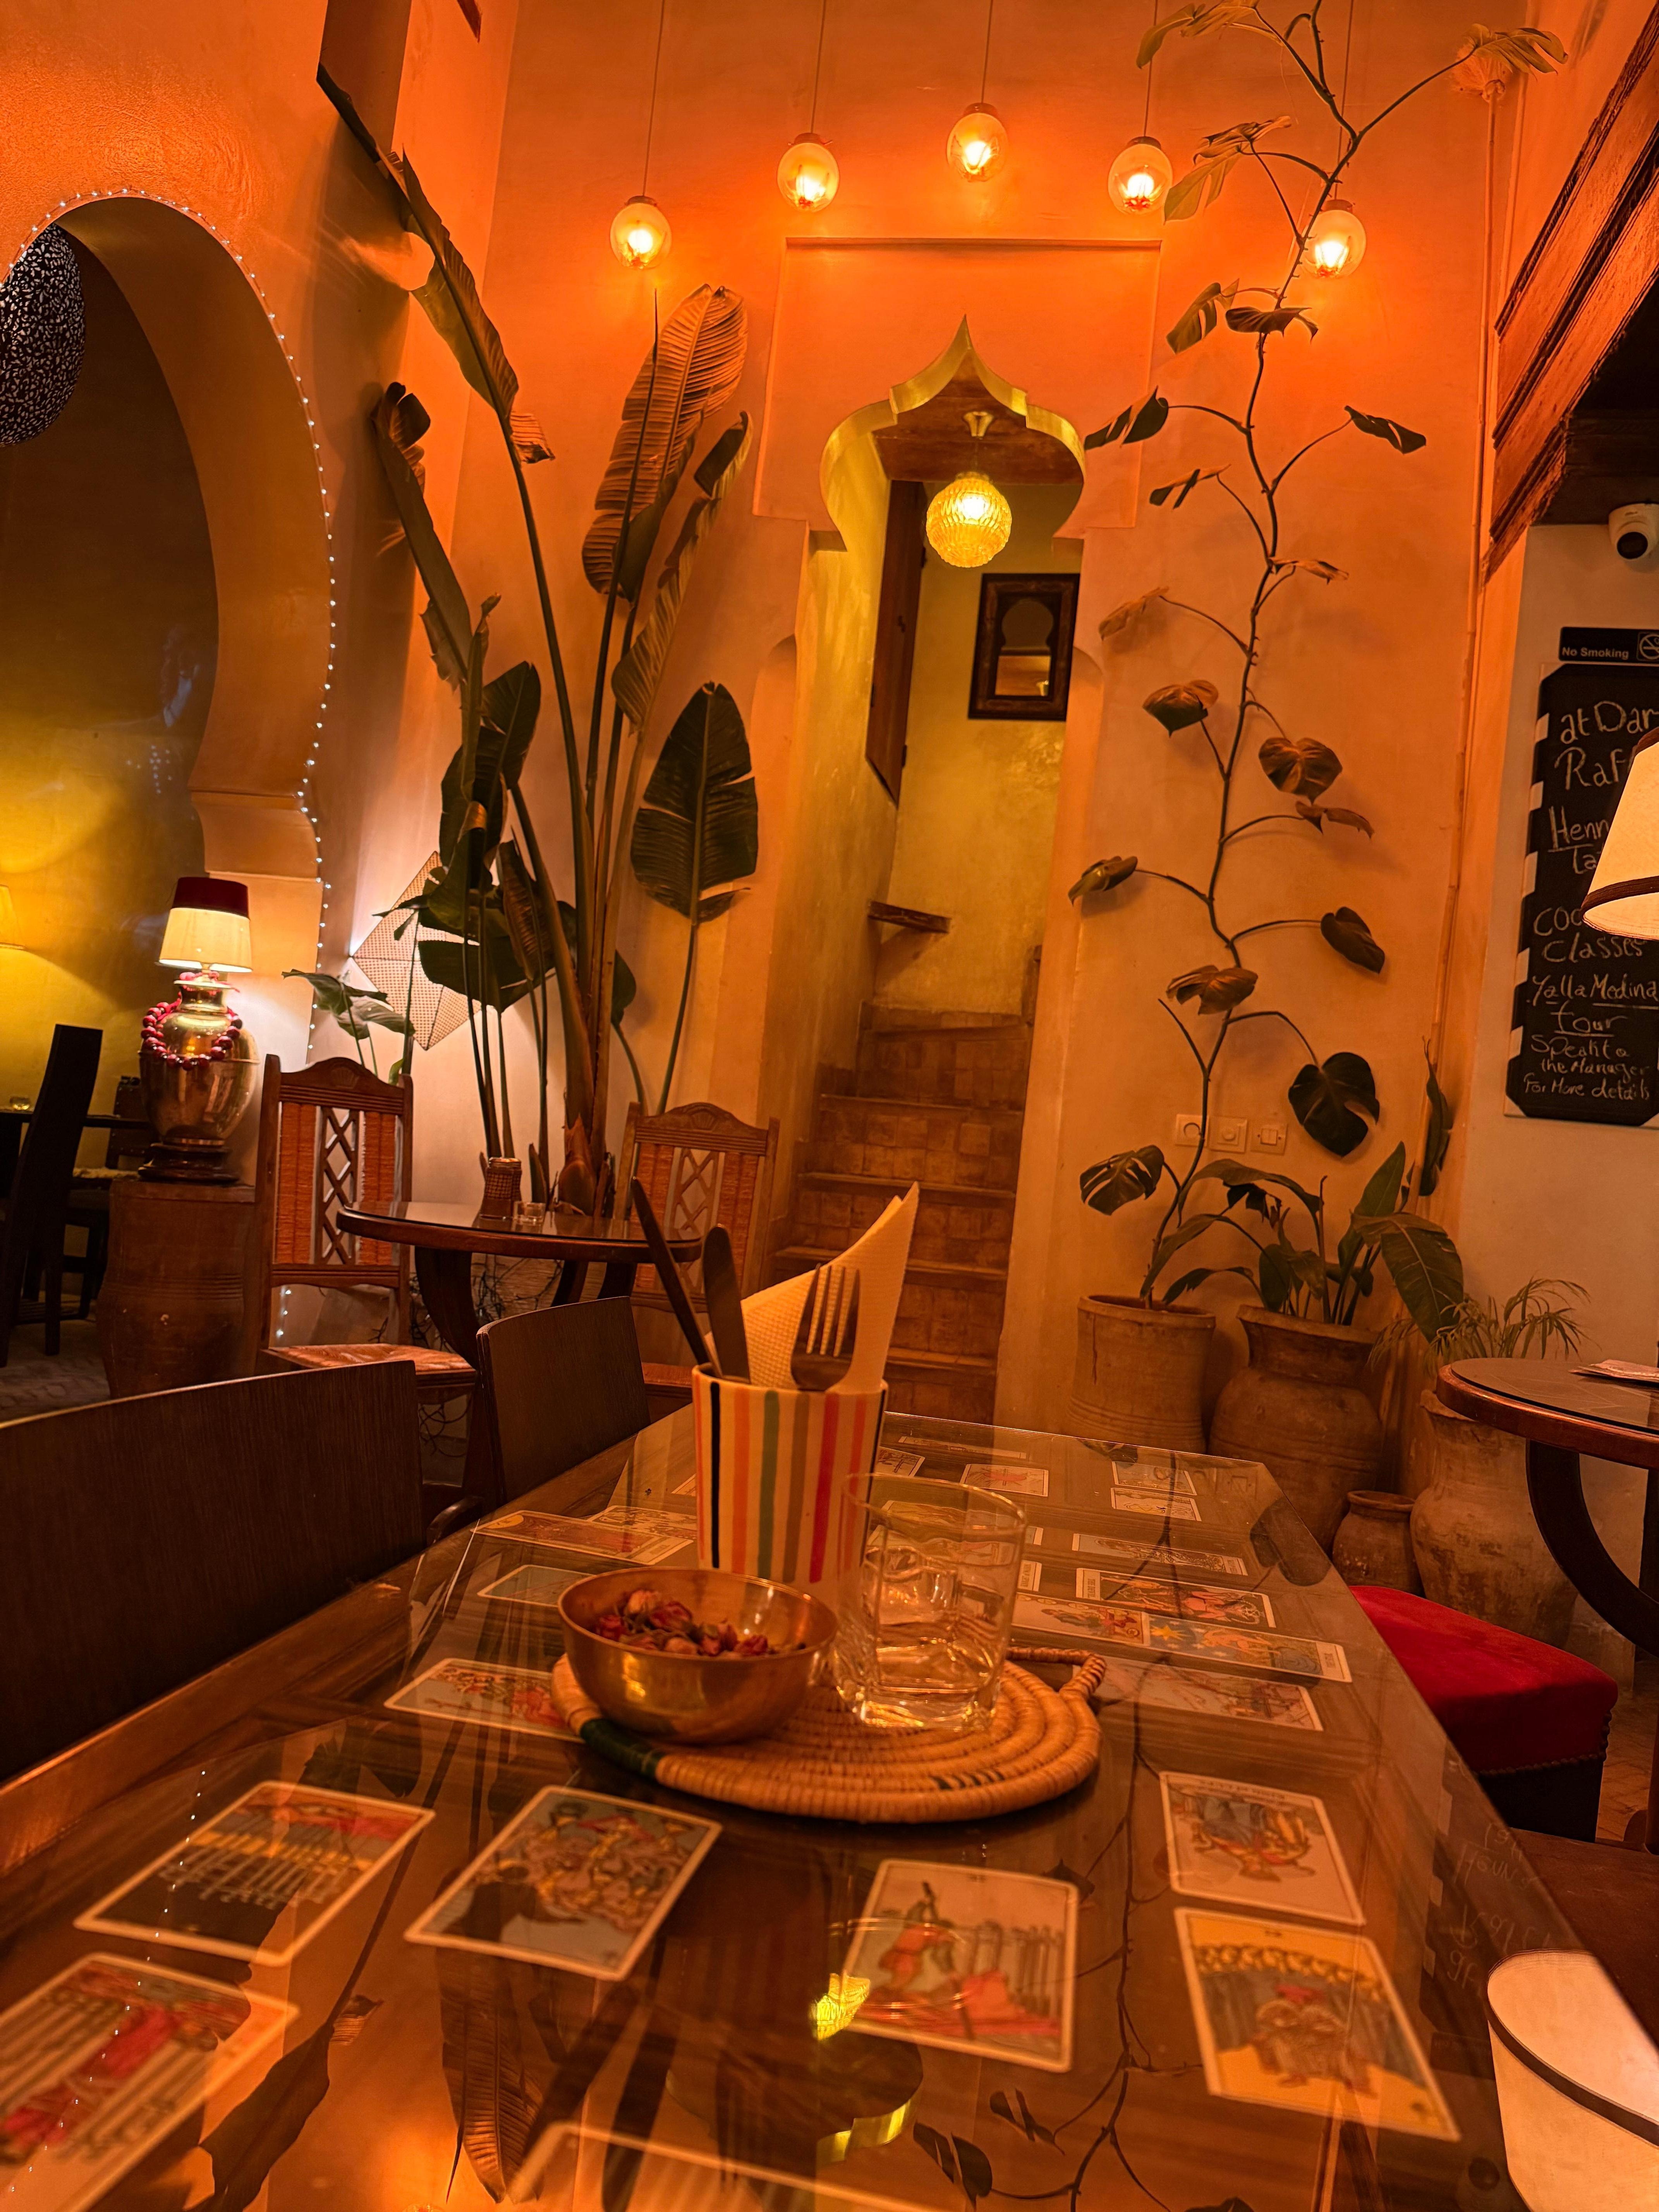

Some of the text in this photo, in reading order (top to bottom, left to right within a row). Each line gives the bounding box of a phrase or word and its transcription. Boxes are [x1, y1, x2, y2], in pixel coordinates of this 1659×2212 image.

[1562, 647, 1629, 658] No Smoking
[1560, 708, 1591, 744] at
[1549, 805, 1610, 849] Henn
[1532, 973, 1659, 1006] Yalla Medina
